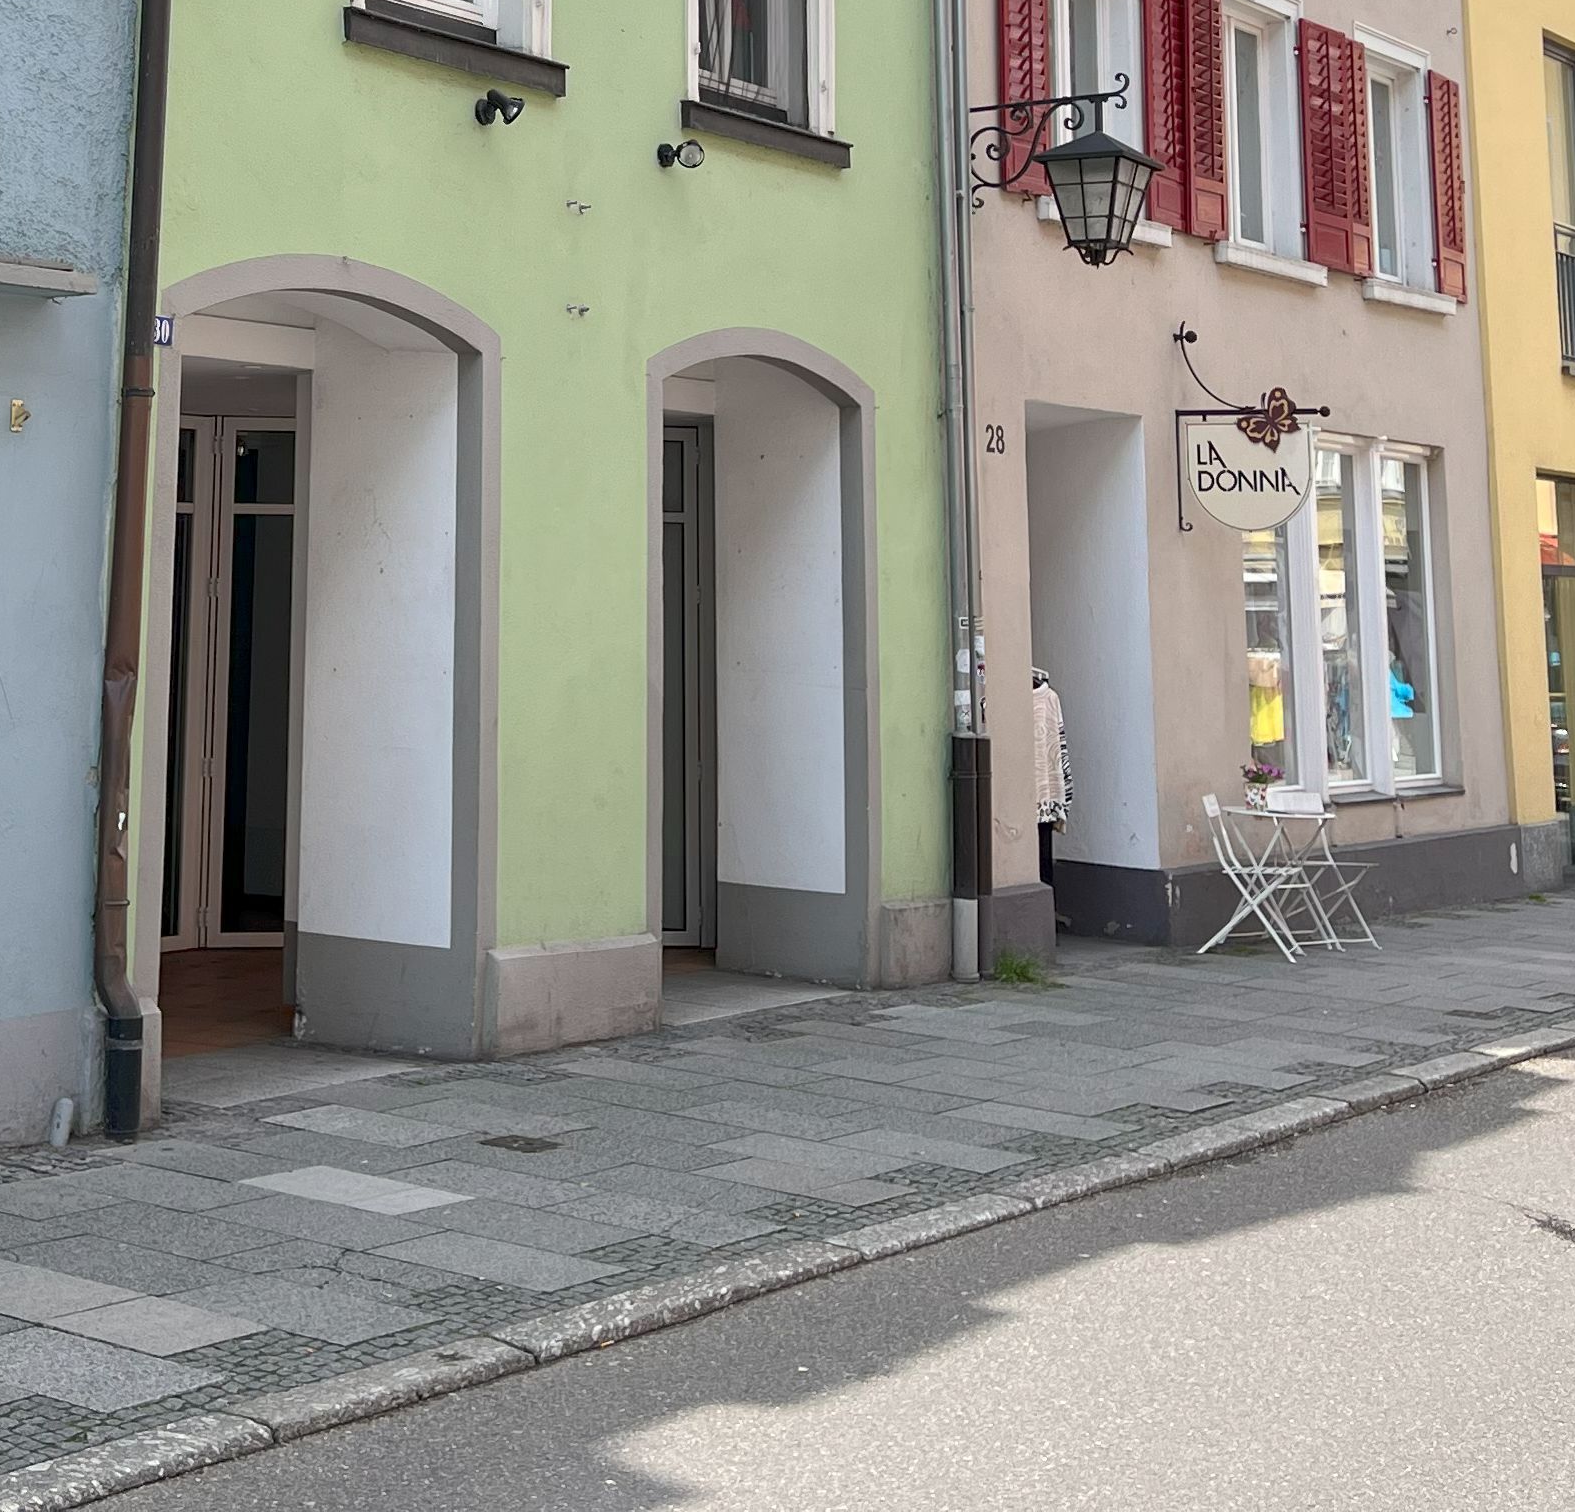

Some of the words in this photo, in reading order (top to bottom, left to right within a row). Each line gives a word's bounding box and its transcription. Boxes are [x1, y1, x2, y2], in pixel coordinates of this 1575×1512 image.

[154, 318, 170, 343] 30
[985, 424, 1005, 454] 28
[1197, 440, 1227, 469] LA
[1198, 467, 1301, 496] DONNA
